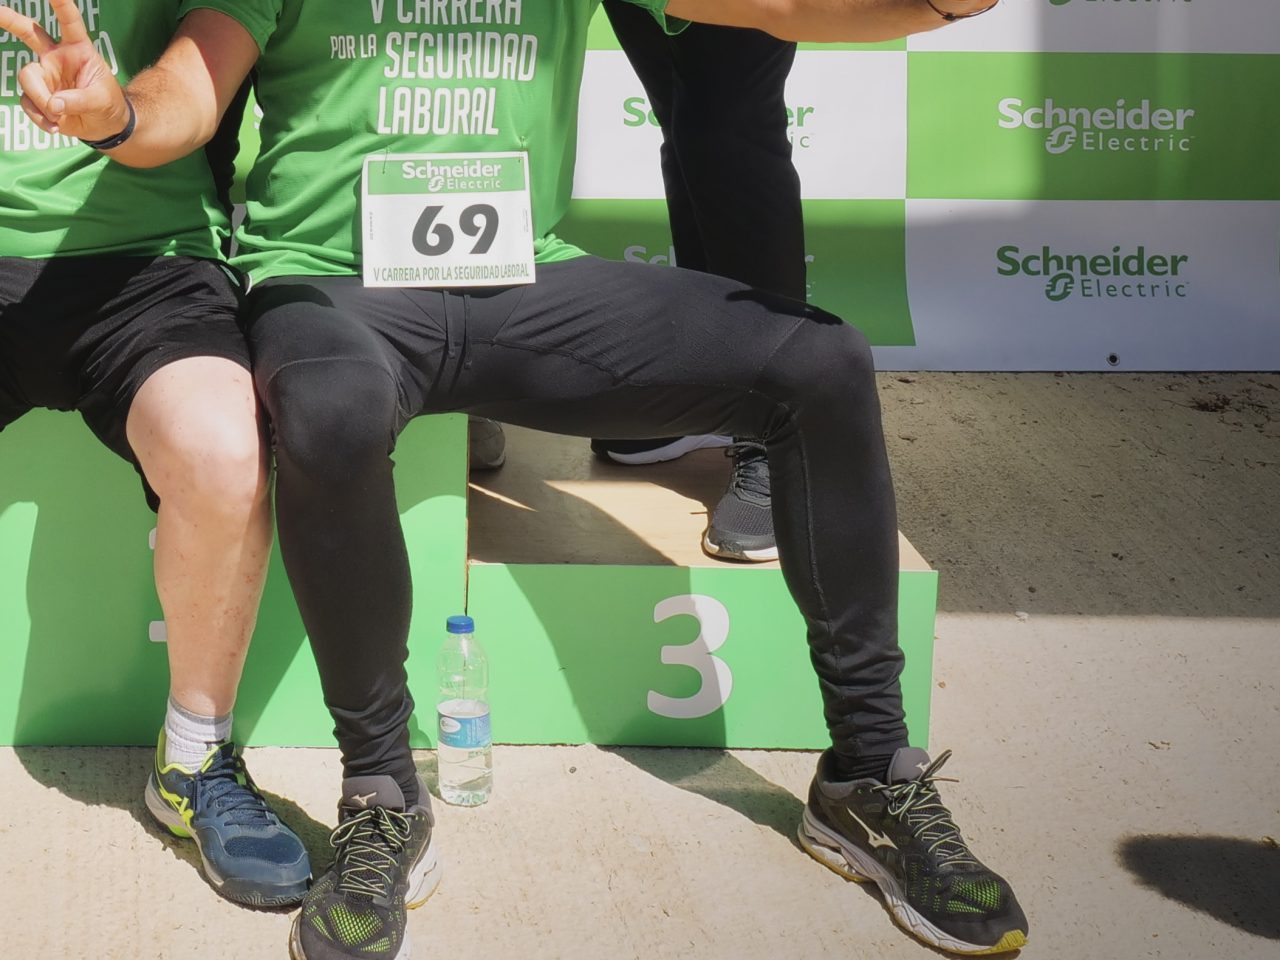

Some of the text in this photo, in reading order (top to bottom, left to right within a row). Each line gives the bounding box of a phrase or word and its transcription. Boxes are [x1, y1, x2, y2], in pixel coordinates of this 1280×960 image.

[330, 32, 538, 81] POR LA SEGURIDAD
[377, 86, 499, 135] LABORAL
[997, 98, 1194, 130] Schneider
[1082, 132, 1190, 151] Electric
[402, 160, 501, 179] Schneider
[447, 179, 501, 189] Electric
[412, 204, 499, 256] 69
[373, 263, 529, 281] V CARRERA POR LA SEGURIDAD LABORAL
[997, 246, 1188, 277] Schneider
[1082, 279, 1186, 298] Electric
[647, 595, 733, 719] 3
